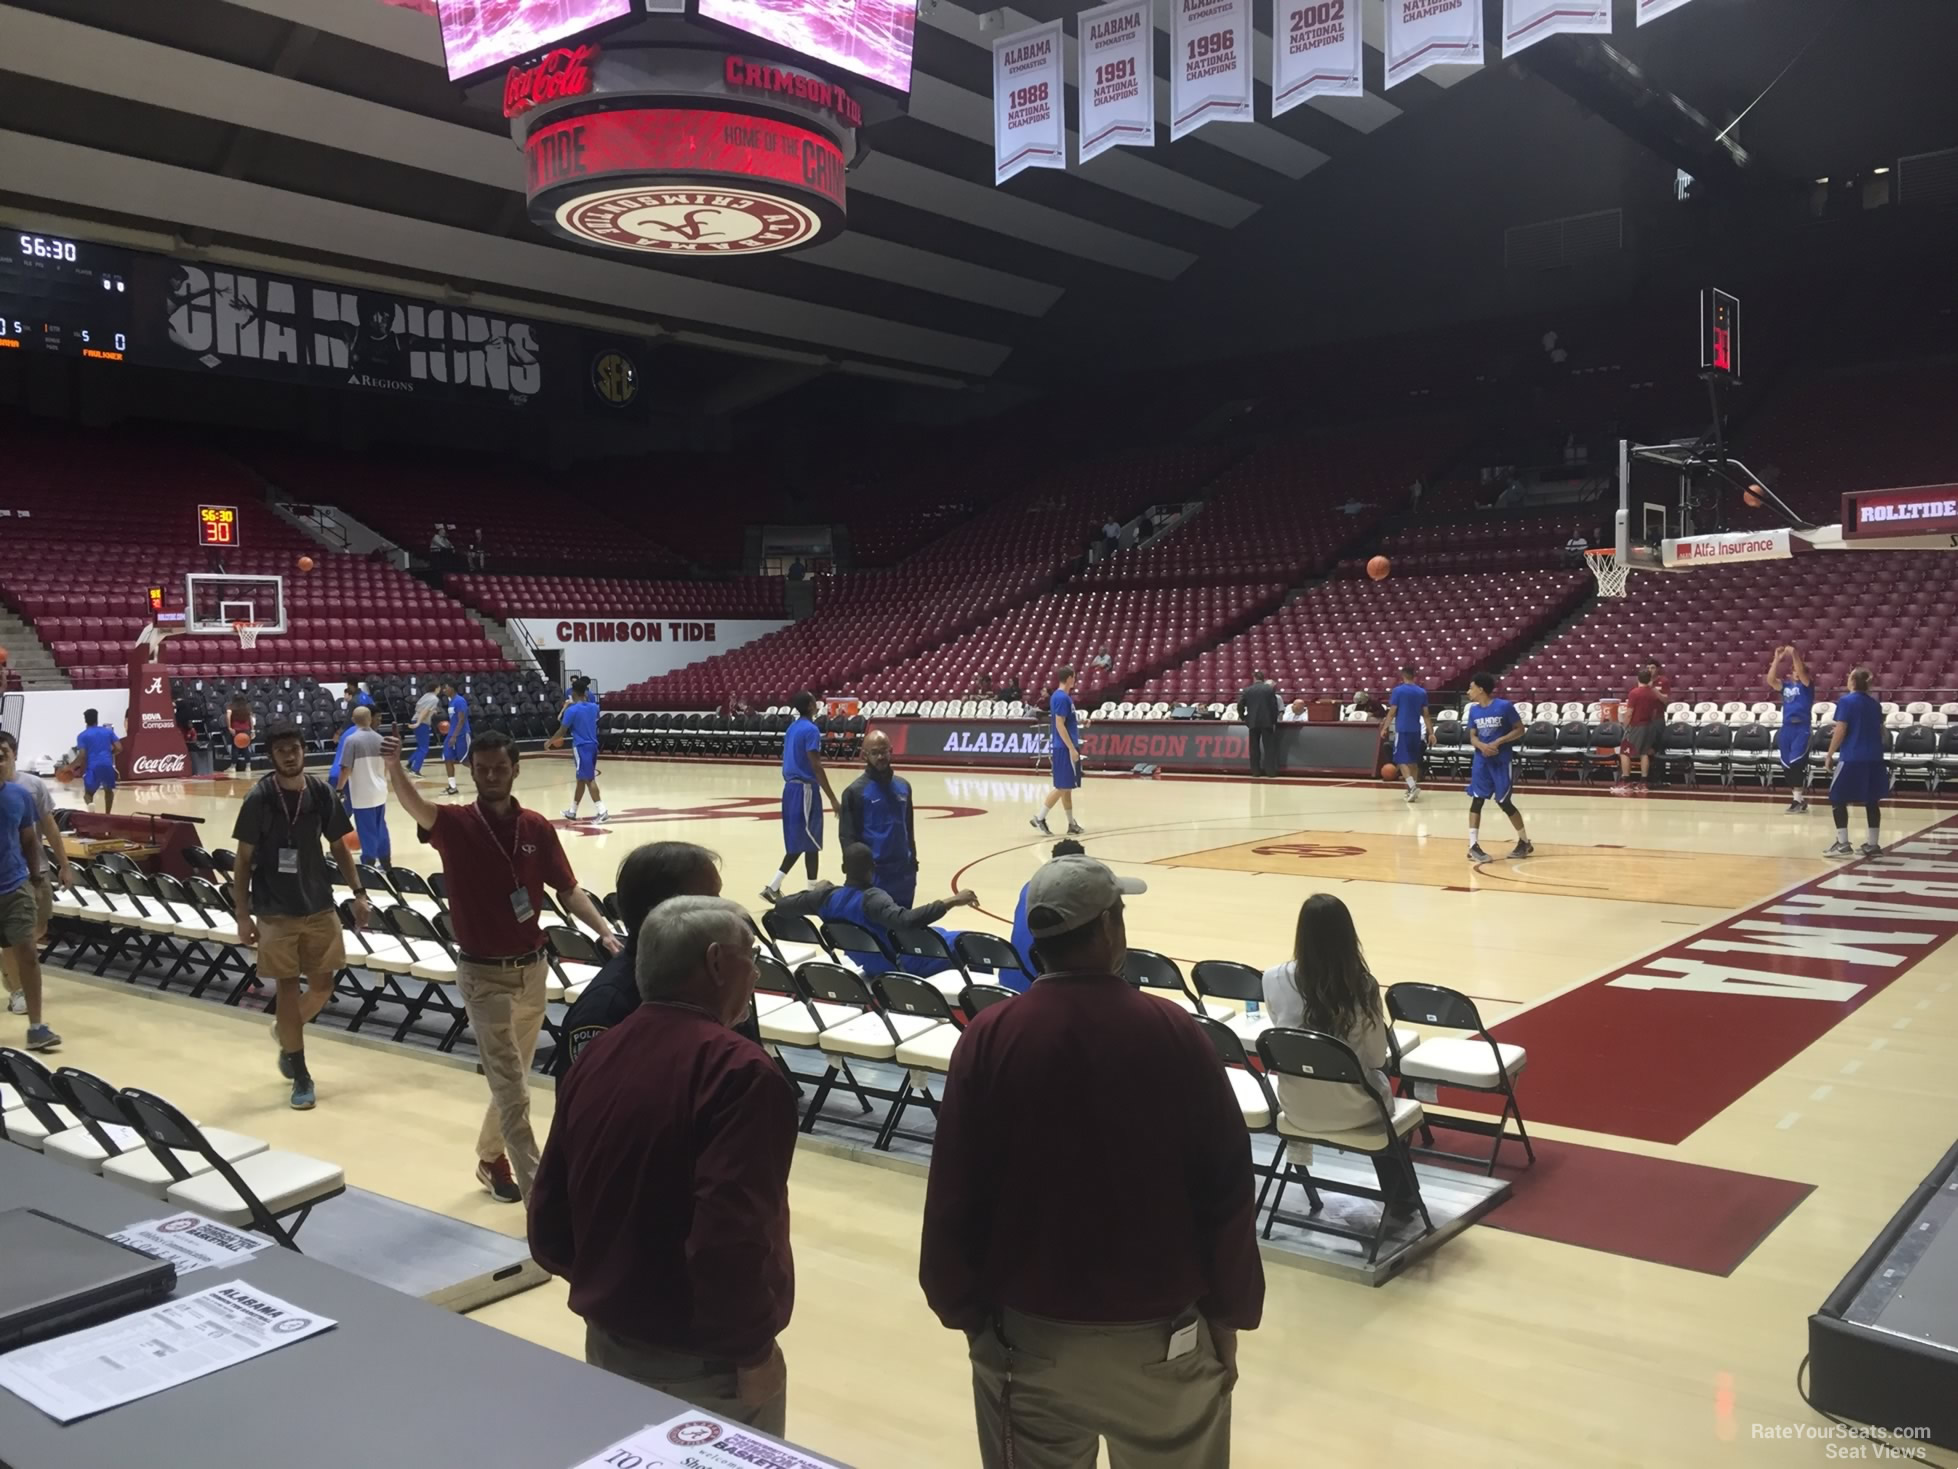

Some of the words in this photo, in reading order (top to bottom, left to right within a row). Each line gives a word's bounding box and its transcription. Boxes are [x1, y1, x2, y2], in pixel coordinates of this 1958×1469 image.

[1289, 1, 1344, 32] 2002
[1403, 0, 1462, 23] CHAMPIONS
[1090, 12, 1141, 41] ALABAMA
[1289, 22, 1344, 45] NATIONAL
[1095, 31, 1136, 49] GYMNASTICS
[1187, 29, 1234, 60] 1996
[1289, 33, 1344, 55] CHAMPIONS
[1004, 39, 1051, 67] ALABAMA
[1186, 51, 1236, 73] NATIONAL
[1009, 58, 1047, 75] GYMNASTICS
[1095, 56, 1136, 85] 1991
[1186, 60, 1237, 81] CHAMPIONS
[725, 55, 832, 108] CRIMSON
[1094, 77, 1138, 98] NATIONAL
[1008, 81, 1049, 109] 1988
[1094, 87, 1139, 107] CHAMPIONS
[1008, 102, 1050, 121] NATIONAL
[1008, 111, 1050, 130] CHAMPIONS
[724, 127, 759, 150] HOME
[20, 235, 77, 262] 56:30
[167, 265, 541, 395] CHAMIONS
[115, 333, 126, 351] 0
[201, 509, 233, 522] 56:30
[207, 521, 230, 542] 30
[1694, 543, 1715, 558] Alfa
[1718, 539, 1773, 555] Insurance
[556, 621, 662, 642] CRIMSON
[669, 622, 716, 642] TIDE
[142, 721, 175, 729] Compass
[1083, 735, 1188, 757] RIMSON
[573, 1030, 600, 1042] POLI
[218, 1288, 285, 1319] ALABAMA
[712, 1441, 787, 1469] BASKET
[723, 1436, 799, 1468] CRIMSON
